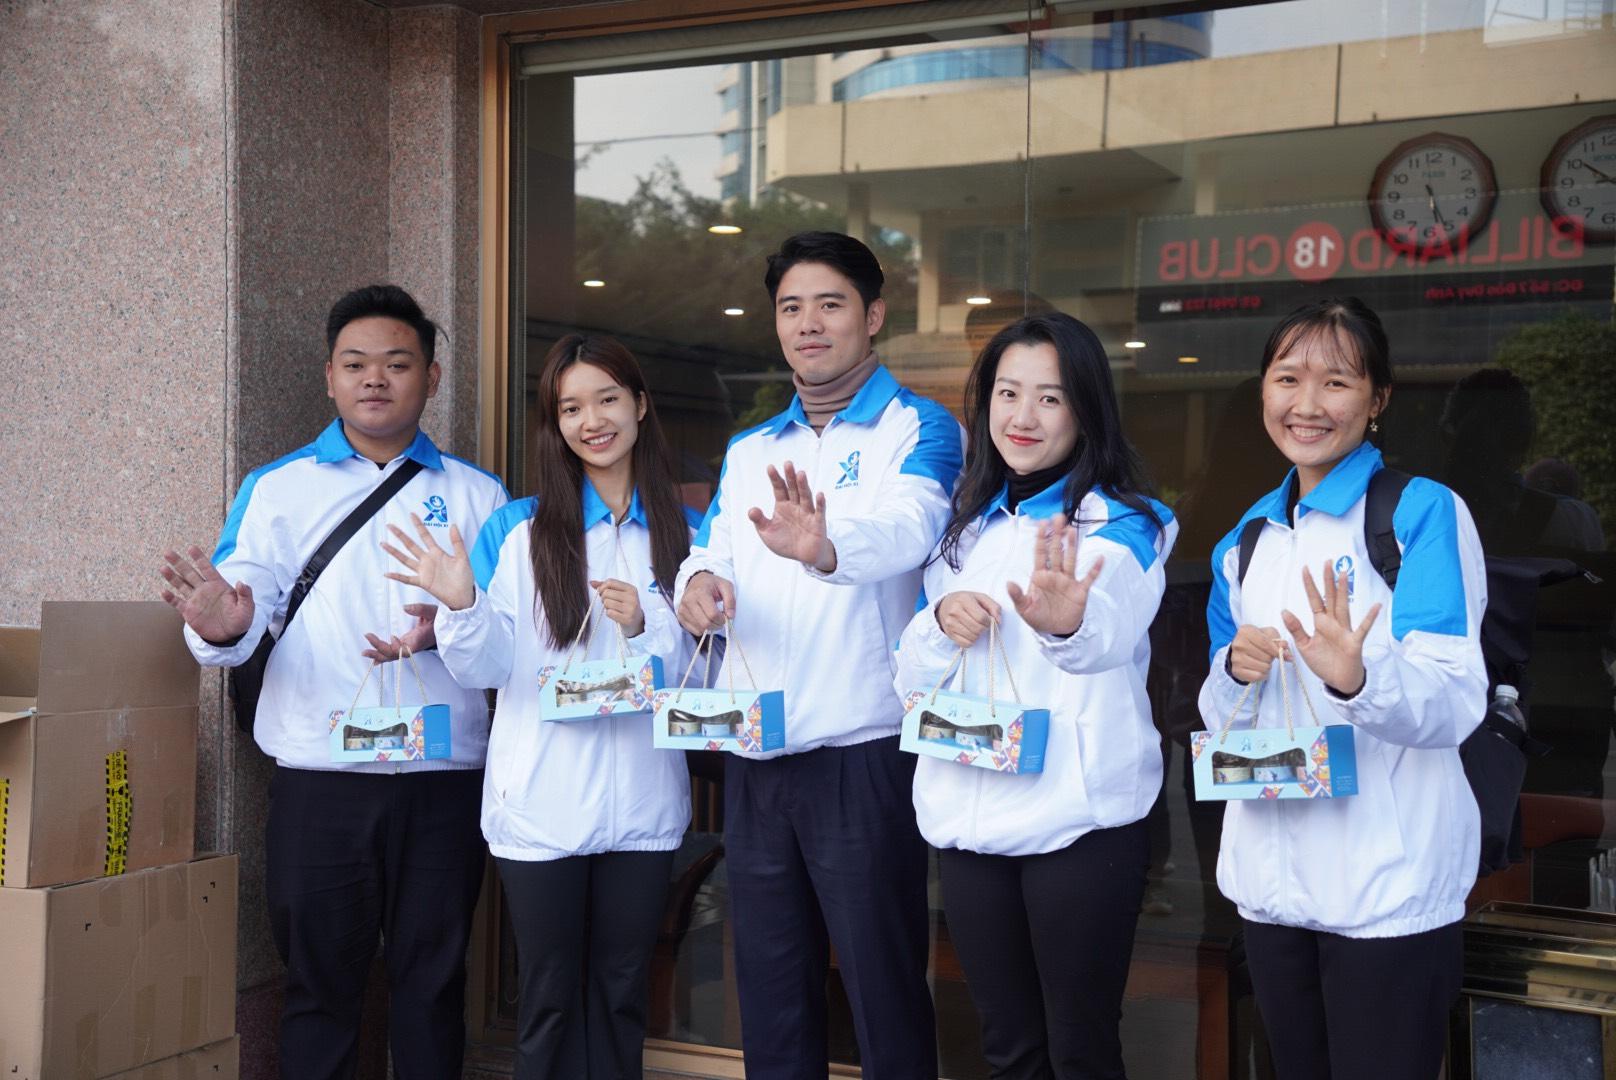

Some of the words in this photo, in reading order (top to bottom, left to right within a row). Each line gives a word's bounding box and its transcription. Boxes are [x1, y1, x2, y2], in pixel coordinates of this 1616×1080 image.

[1584, 141, 1595, 152] 11
[1408, 158, 1419, 168] 11
[1426, 152, 1442, 163] 12
[1452, 157, 1457, 166] 1
[1568, 159, 1582, 169] 10
[1394, 174, 1408, 184] 10
[1461, 169, 1472, 181] 2
[1561, 177, 1574, 188] 9
[1388, 191, 1400, 202] 9
[1465, 187, 1476, 199] 3
[1568, 196, 1580, 207] 8
[1393, 209, 1405, 220] 8
[1456, 206, 1468, 216] 4
[1584, 207, 1595, 218] 7
[1602, 213, 1616, 224] 6
[1424, 227, 1436, 238] 6
